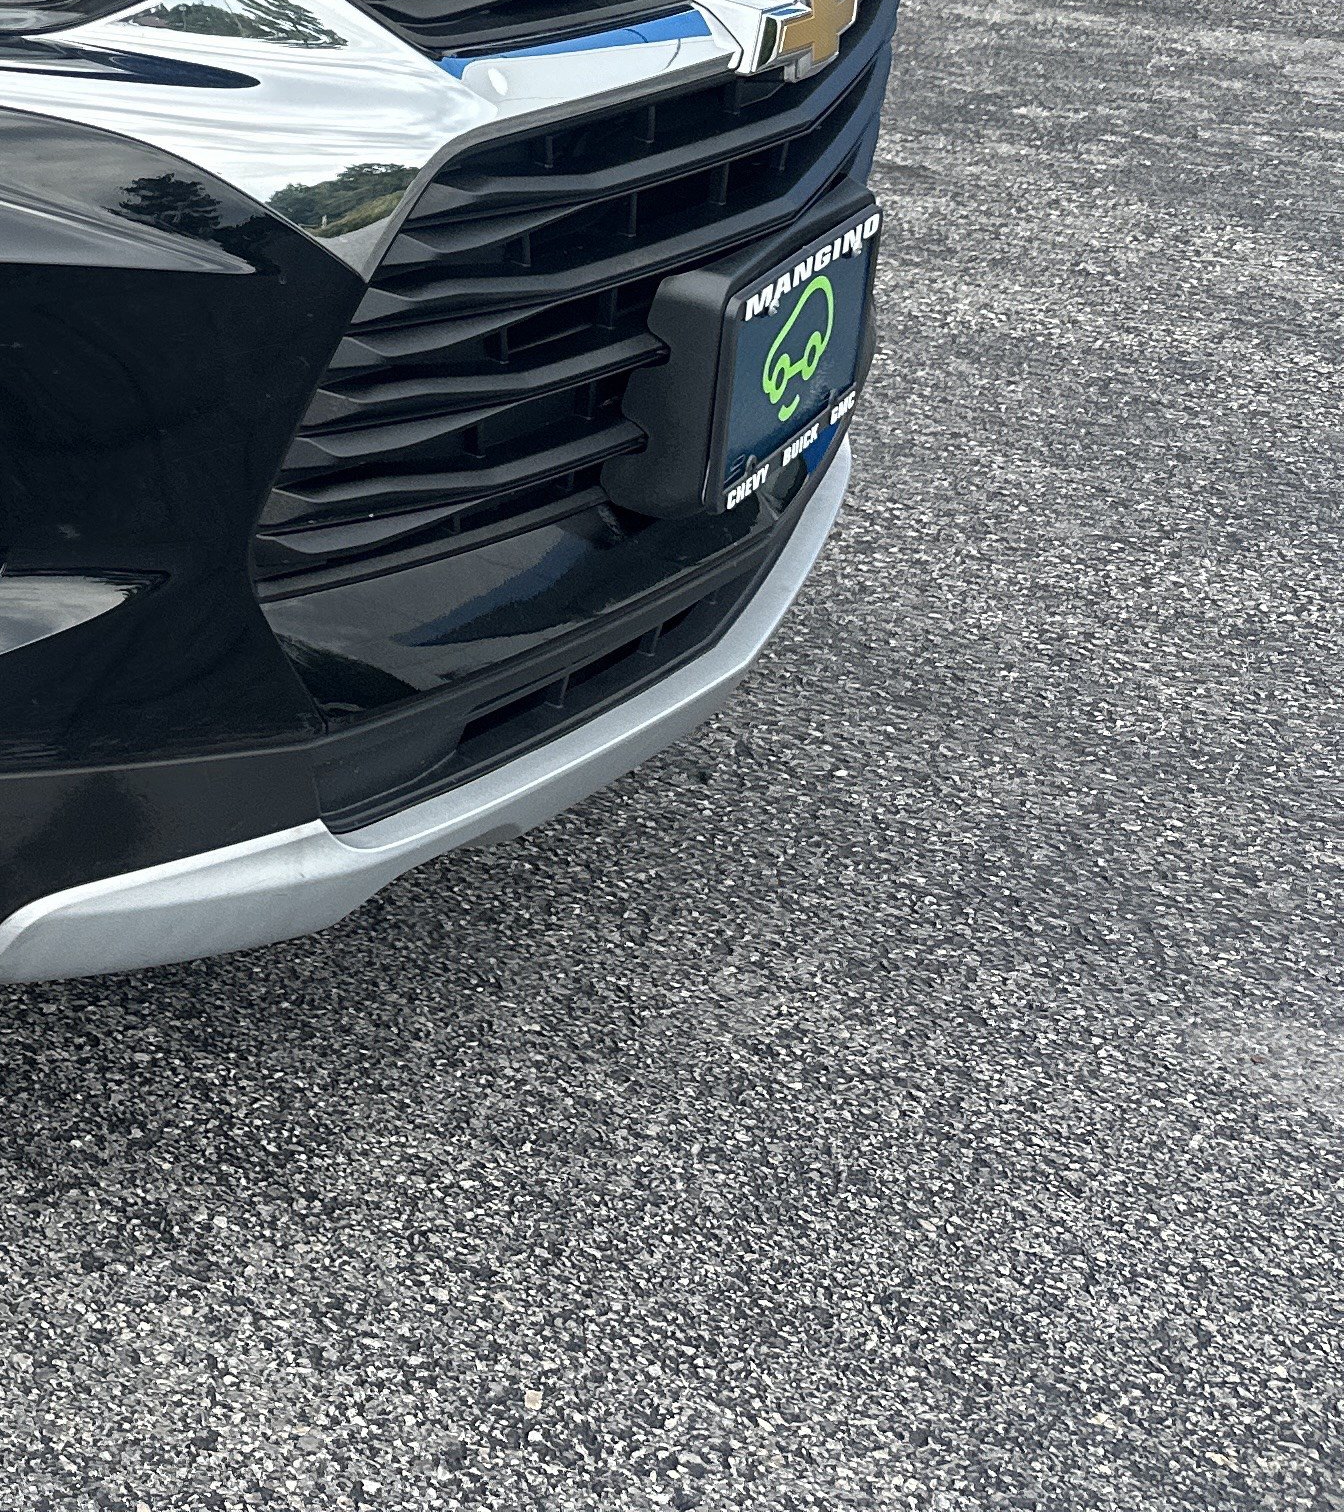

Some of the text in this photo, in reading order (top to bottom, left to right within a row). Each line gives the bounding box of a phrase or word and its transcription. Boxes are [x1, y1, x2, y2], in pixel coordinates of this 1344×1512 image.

[744, 212, 880, 321] MANGINO
[726, 390, 856, 510] CHEVY BUICK GMC
